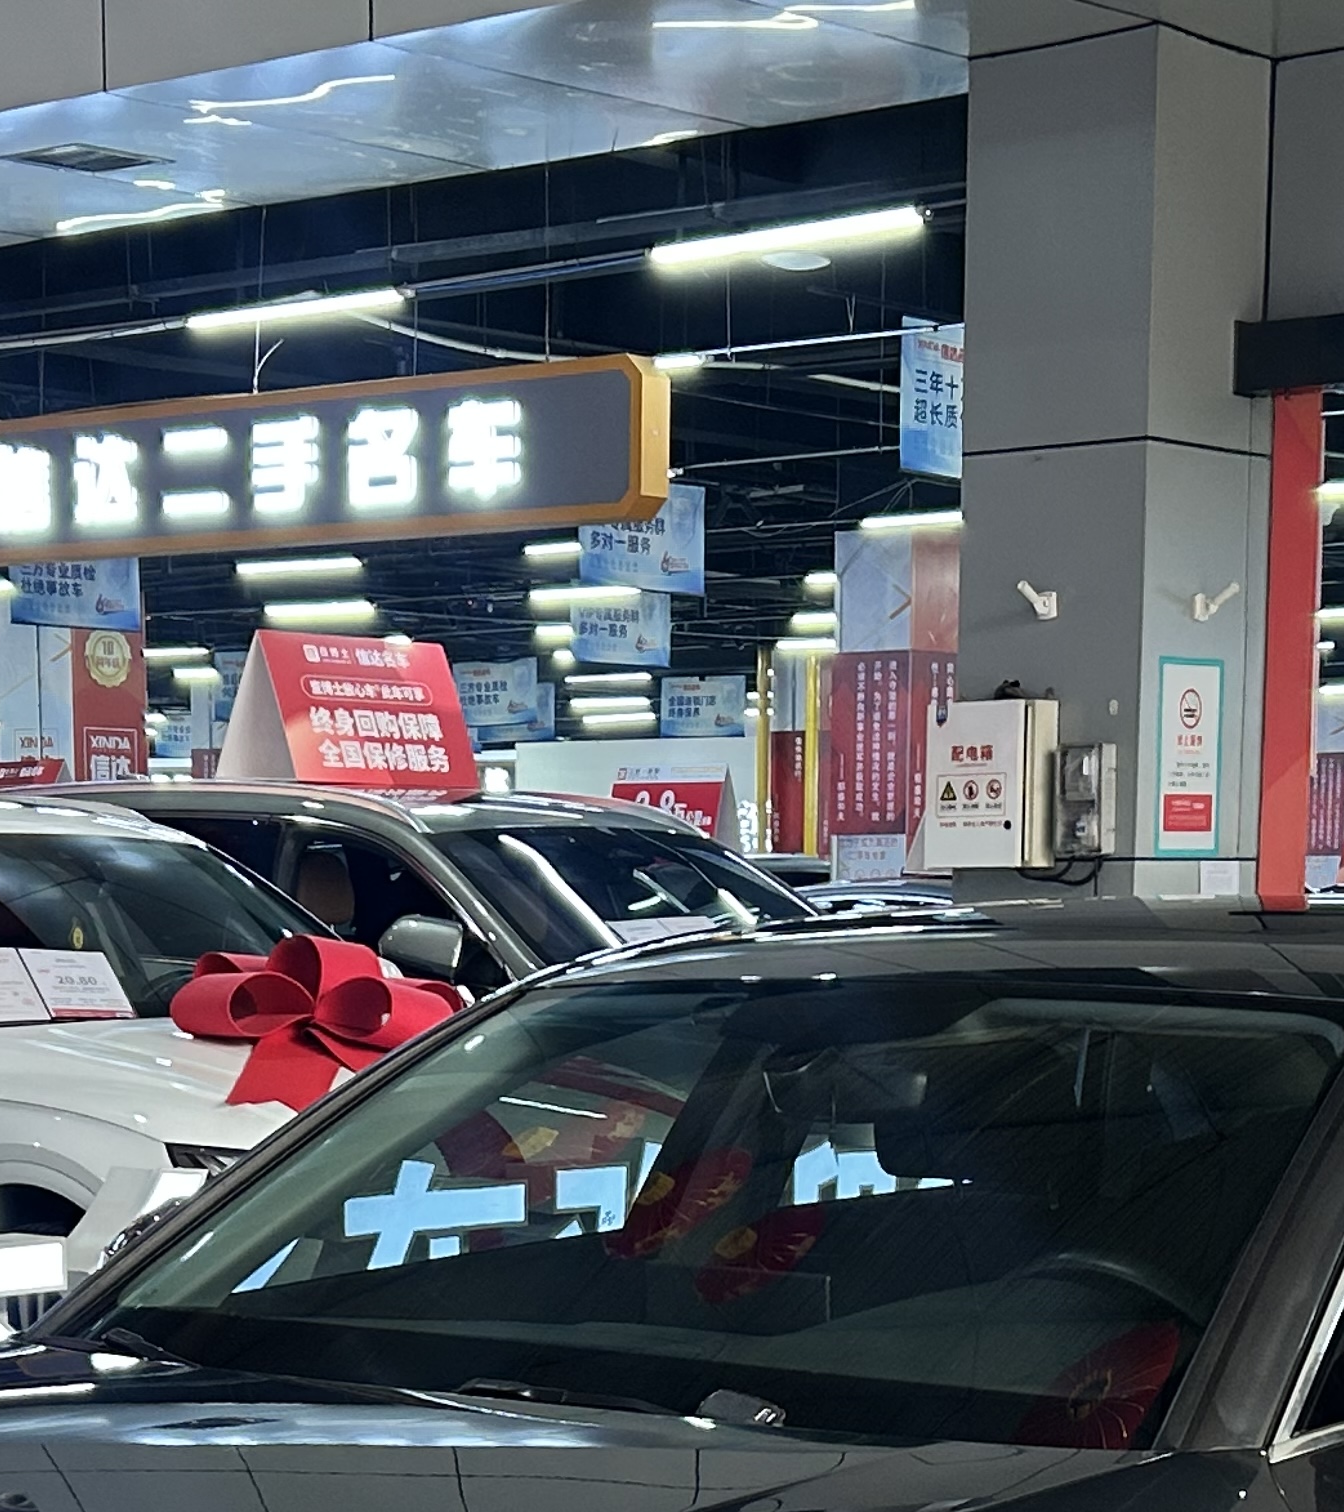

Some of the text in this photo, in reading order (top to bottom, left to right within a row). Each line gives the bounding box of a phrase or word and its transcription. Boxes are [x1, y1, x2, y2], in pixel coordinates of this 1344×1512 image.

[914, 369, 963, 401] 三年十
[914, 397, 963, 429] 超长质
[309, 705, 445, 742] 终身回购保障
[318, 738, 451, 774] 全国保修服务
[950, 744, 994, 762] 配电箱
